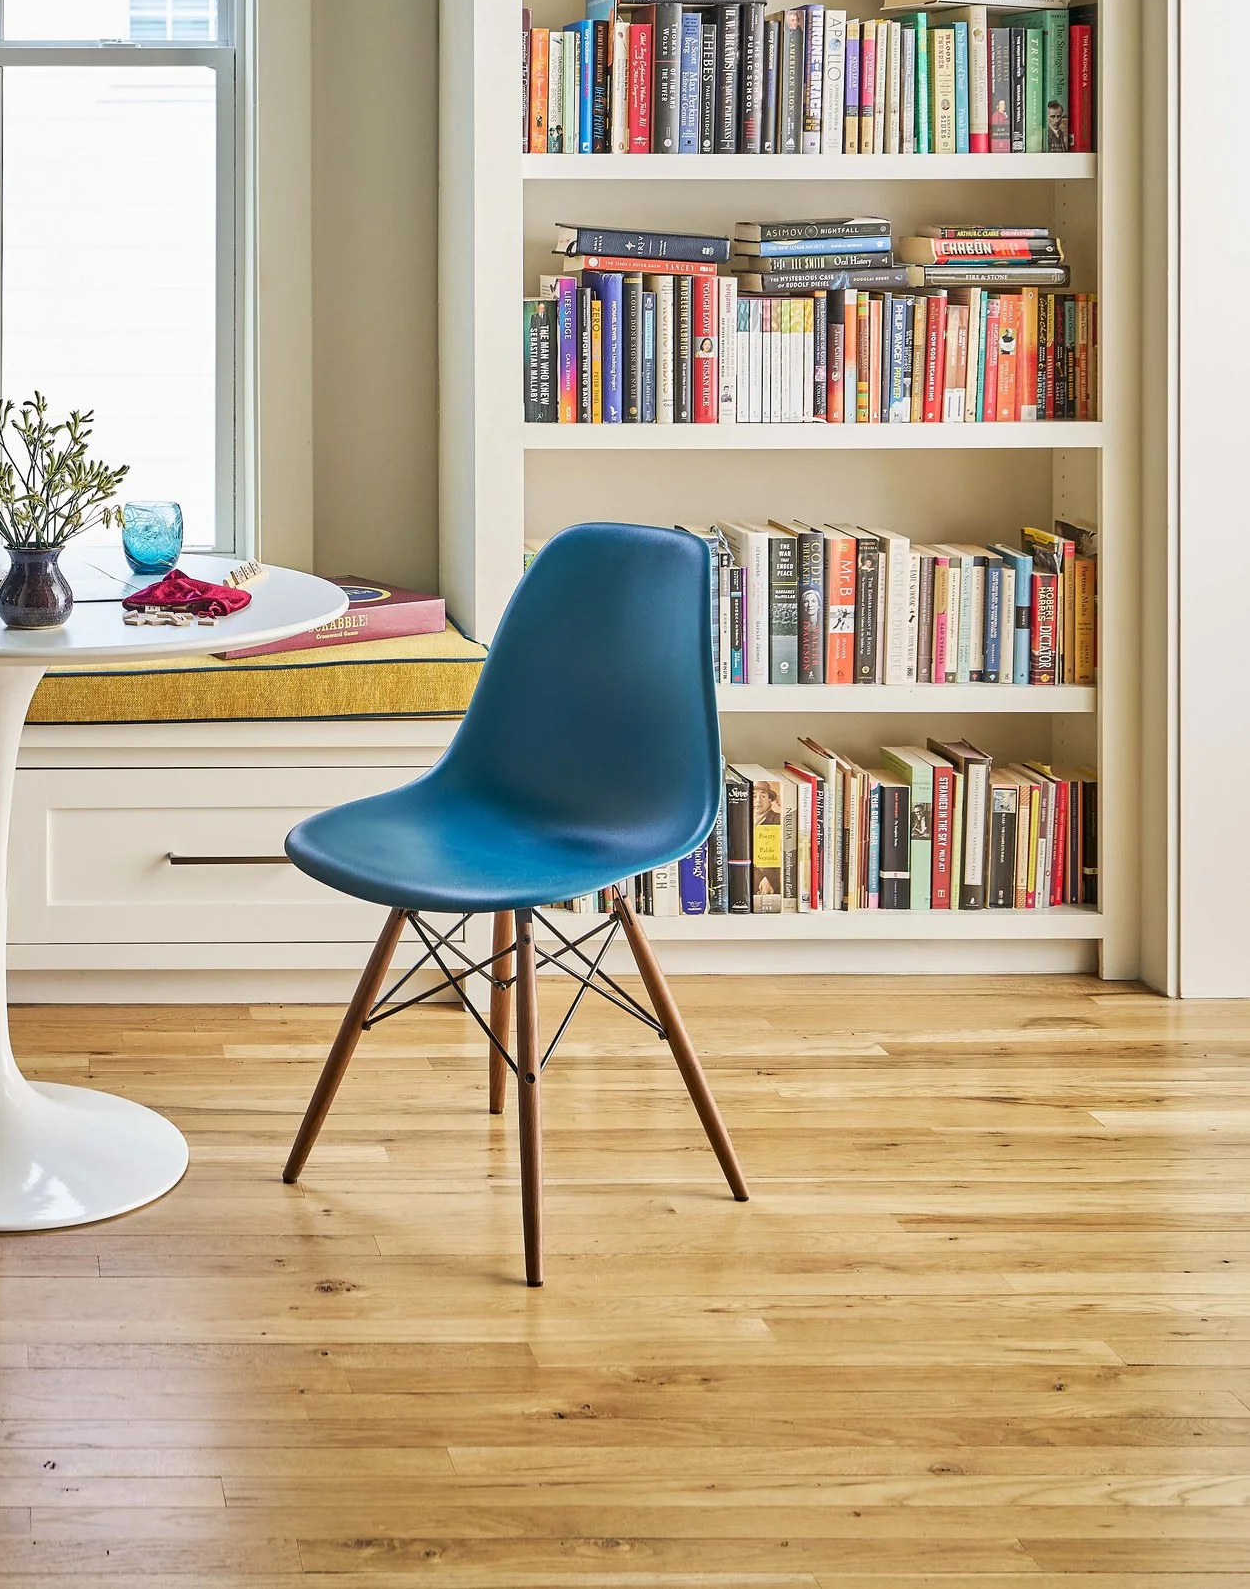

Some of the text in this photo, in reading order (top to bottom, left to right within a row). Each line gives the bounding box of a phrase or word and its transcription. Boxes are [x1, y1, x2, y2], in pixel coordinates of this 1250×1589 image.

[703, 31, 714, 81] THEBES
[745, 35, 754, 113] PUBLIC SCHOOL
[687, 71, 698, 127] Max Perkins
[702, 281, 710, 334] TOUGH LOVE
[893, 304, 904, 399] PHILIP YANCEY PRAYER
[701, 359, 710, 407] SUSAN RICE
[802, 542, 811, 586] BREAKER
[810, 542, 822, 585] CODE
[1038, 625, 1053, 669] DICTATOR
[938, 777, 951, 809] STRANDED
[937, 819, 950, 831] THE
[937, 832, 950, 846] SKY
